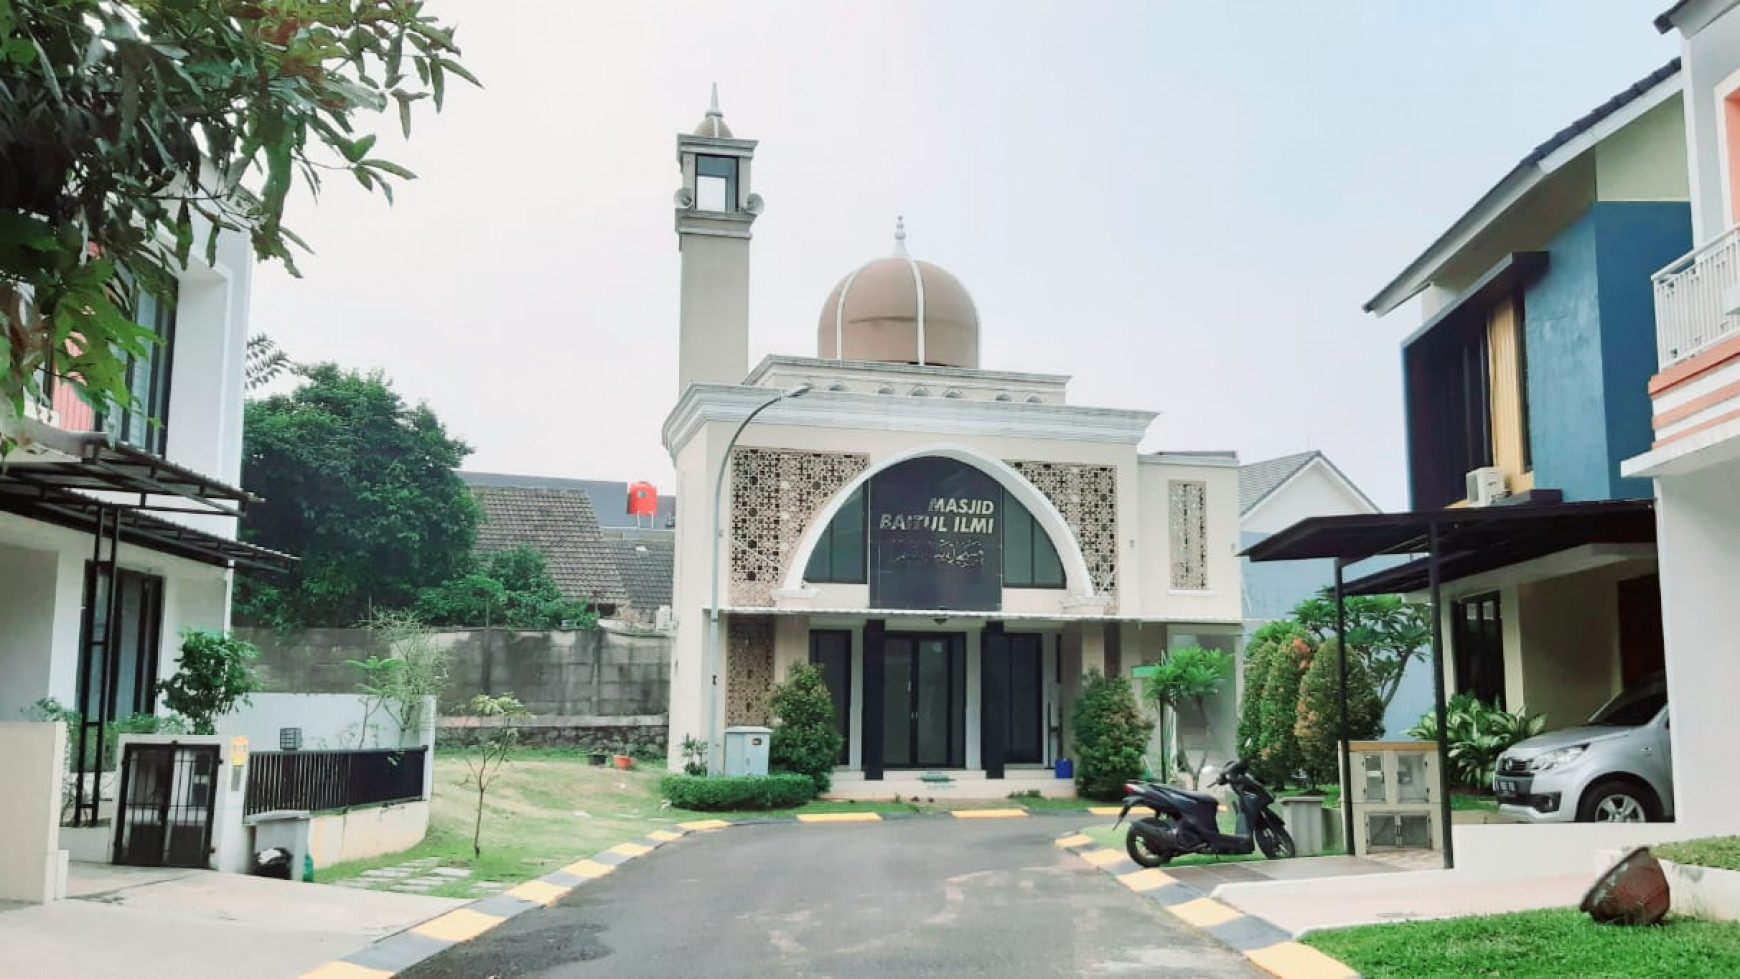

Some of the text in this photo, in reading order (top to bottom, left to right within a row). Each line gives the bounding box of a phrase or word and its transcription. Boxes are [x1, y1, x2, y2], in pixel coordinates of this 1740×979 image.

[928, 498, 994, 514] MASJID
[880, 514, 994, 534] BAITUL ILMI
